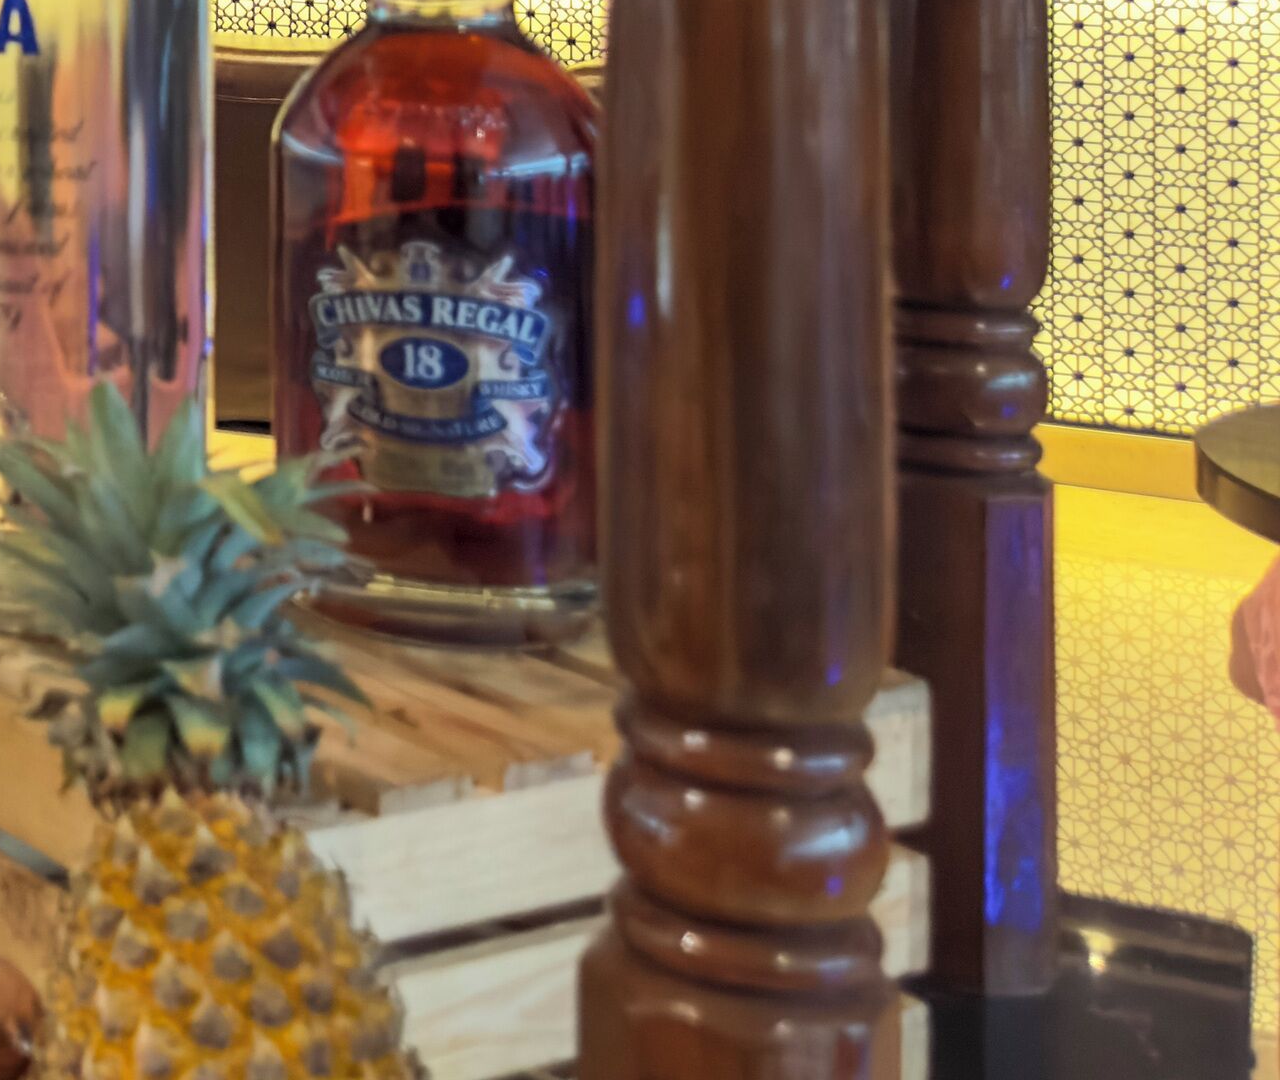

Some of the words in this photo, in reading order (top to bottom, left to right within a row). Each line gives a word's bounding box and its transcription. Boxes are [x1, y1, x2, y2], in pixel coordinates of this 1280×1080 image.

[317, 294, 422, 326] CHIVAS
[431, 296, 538, 344] REGAL
[403, 343, 445, 381] 18
